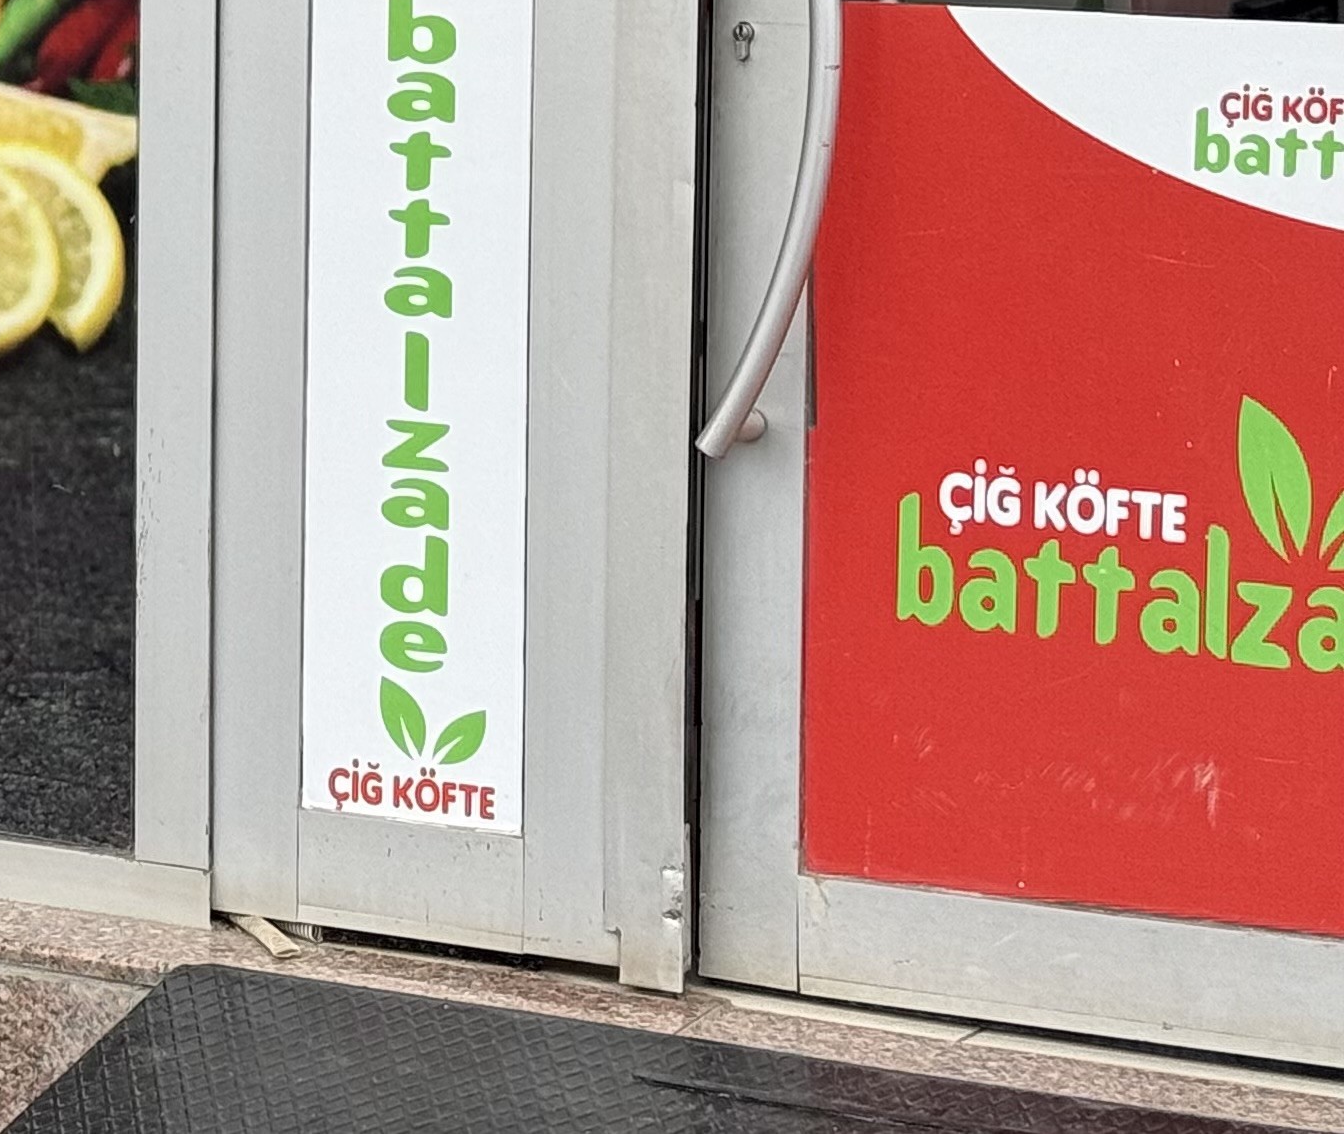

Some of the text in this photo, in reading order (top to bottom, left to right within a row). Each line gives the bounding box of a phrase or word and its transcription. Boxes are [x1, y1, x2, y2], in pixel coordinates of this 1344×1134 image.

[1220, 83, 1273, 128] ÇİĞ
[1194, 107, 1344, 180] batt
[939, 460, 1188, 543] ÇİĞ KÖFTE
[896, 492, 1344, 673] battalza
[328, 760, 495, 818] ÇİĞ KÖFTE
